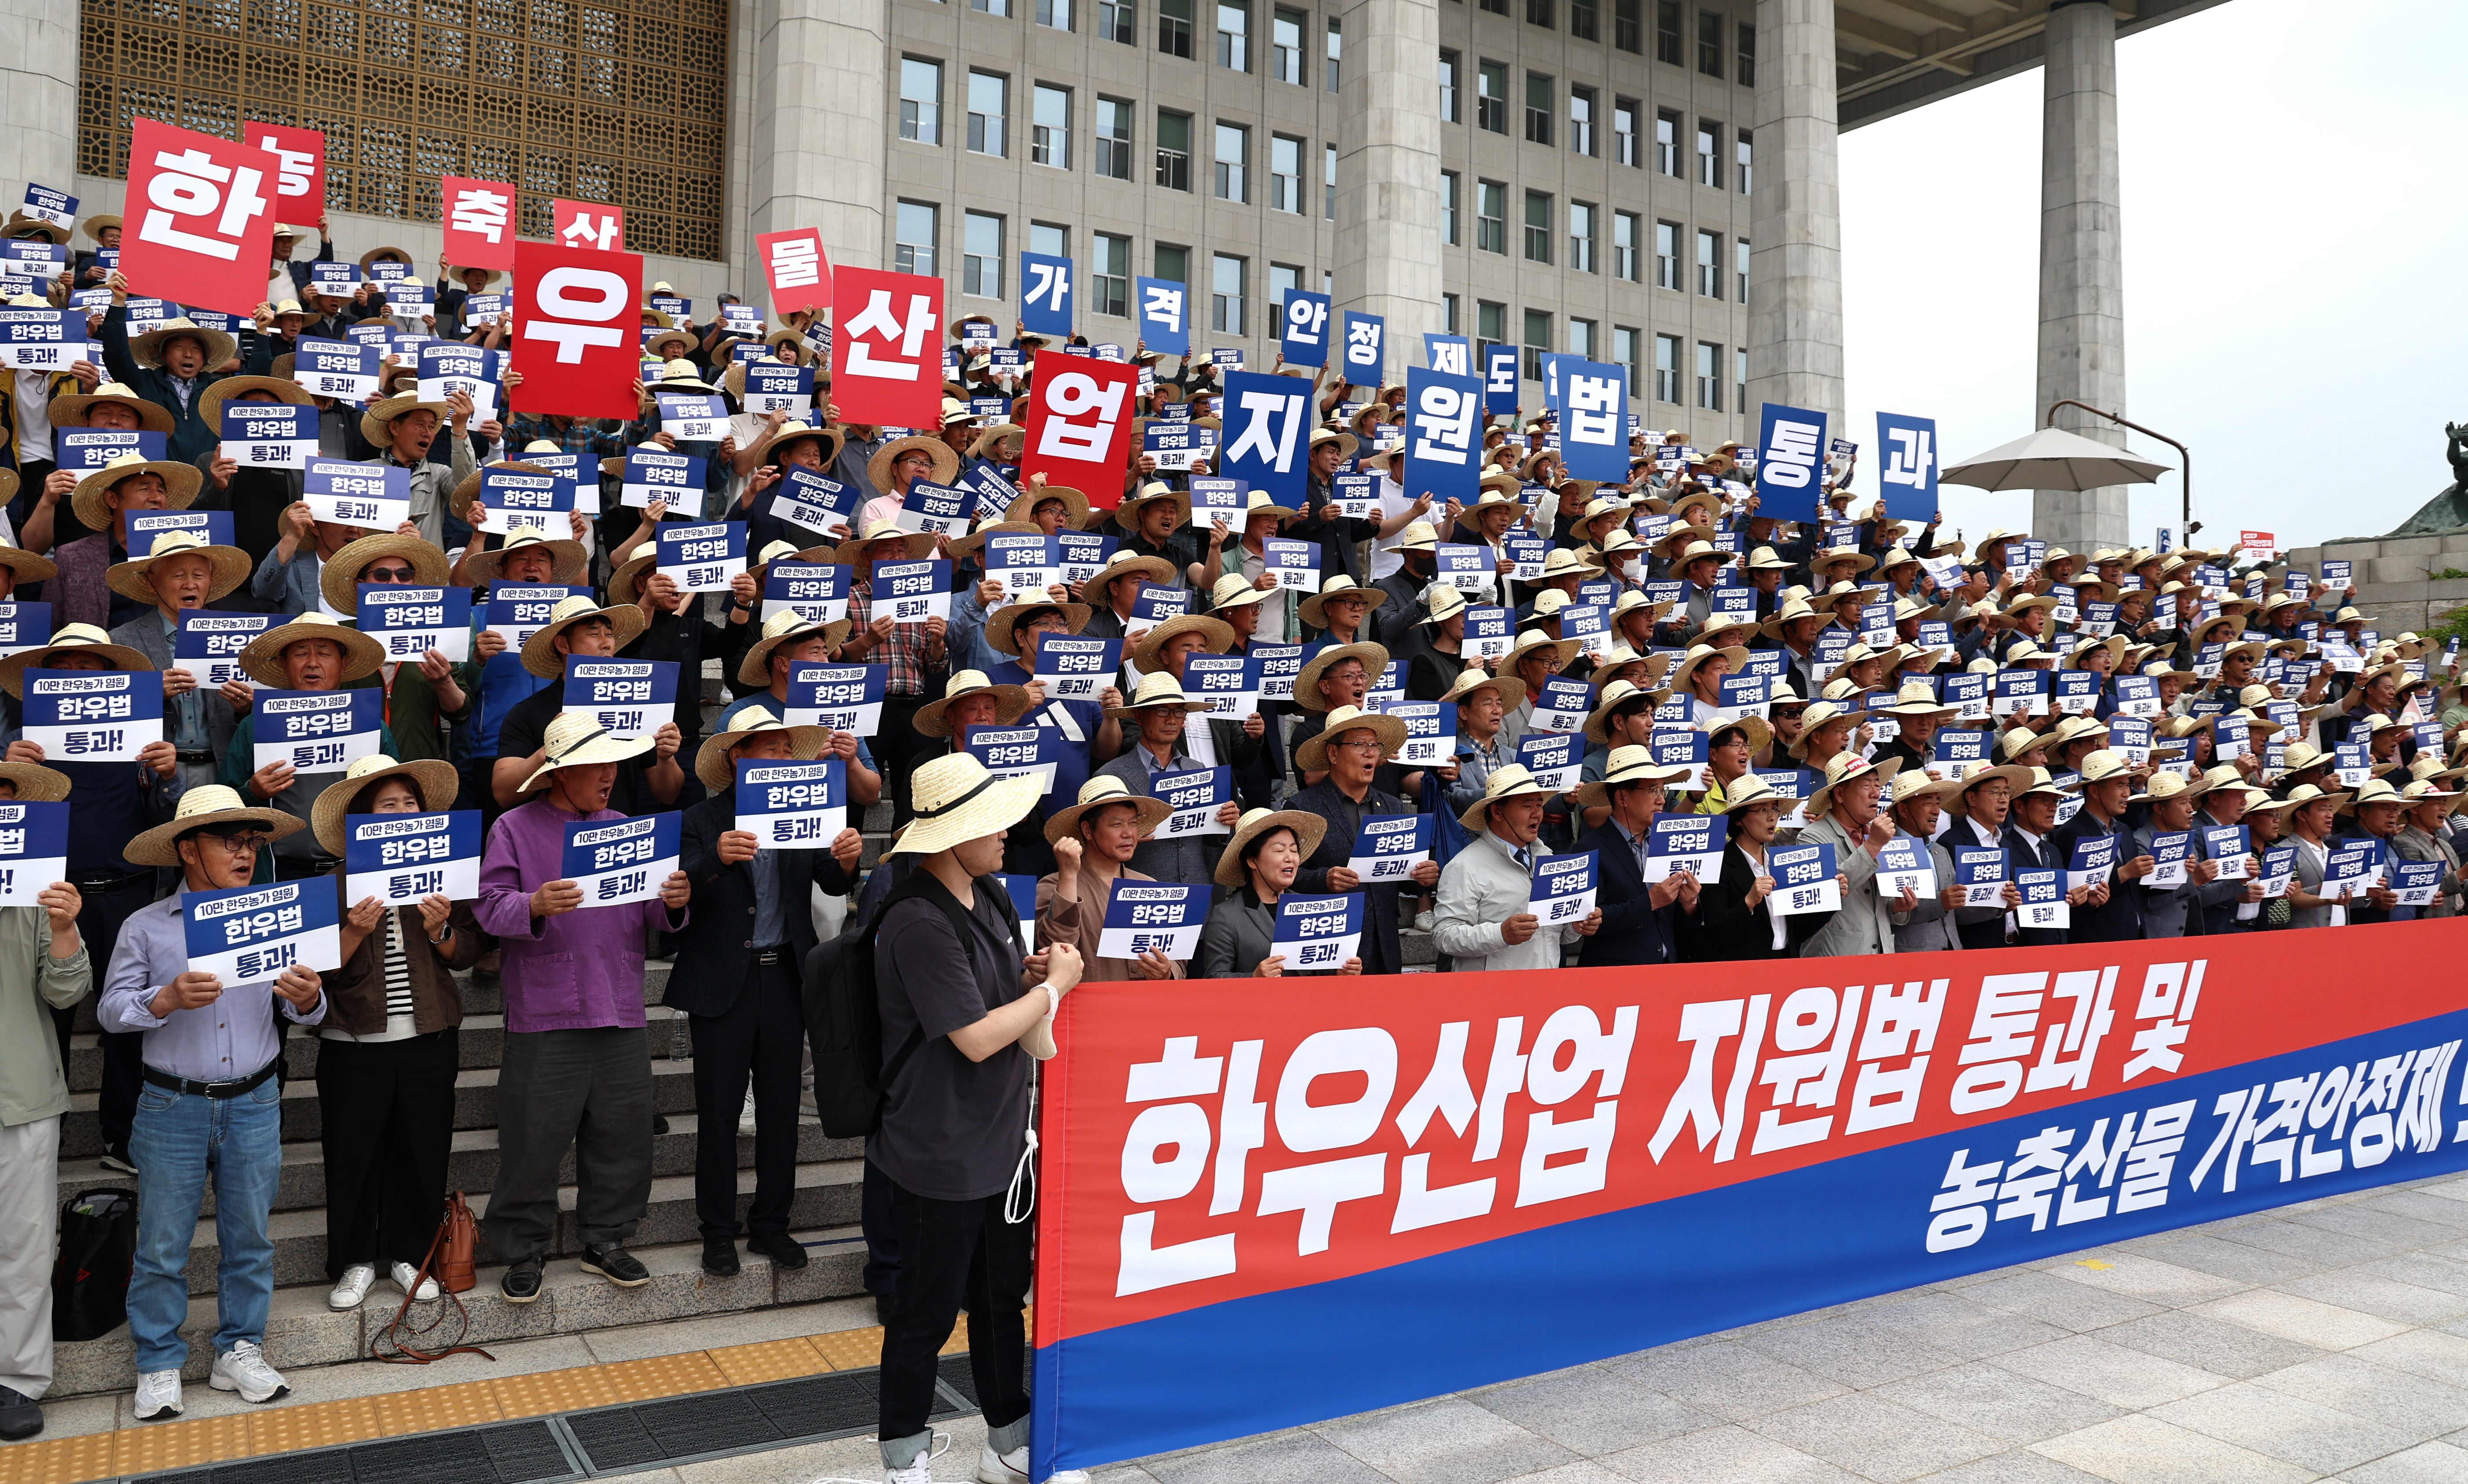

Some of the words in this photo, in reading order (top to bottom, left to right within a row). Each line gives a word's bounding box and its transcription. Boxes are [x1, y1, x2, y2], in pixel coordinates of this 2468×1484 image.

[261, 136, 314, 195] 농
[139, 149, 266, 261] 한
[452, 190, 507, 243] 축
[21, 250, 51, 260] 한우법
[771, 238, 819, 289] 물
[24, 263, 47, 273] 통과!
[324, 272, 350, 280] 한우법
[327, 284, 346, 293] 통과!
[1025, 264, 1069, 311] 가
[398, 294, 422, 302] 한우법
[524, 268, 628, 364] 우
[1144, 287, 1182, 332] 격
[1287, 300, 1327, 344] 안
[11, 325, 62, 340] 한우법
[844, 290, 936, 381] 산
[1349, 321, 1380, 365] 정
[17, 348, 57, 364] 통과!
[317, 355, 360, 371] 한우법
[1432, 342, 1466, 376] 제
[1488, 355, 1514, 392] 도
[320, 377, 354, 393] 통과!
[763, 378, 798, 391] 한우법
[676, 405, 712, 417] 한우법
[1037, 373, 1127, 463] 업
[1569, 375, 1620, 445] 법
[246, 421, 296, 437] 한우법
[684, 423, 711, 436] 통과!
[1227, 392, 1304, 472] 지
[1414, 386, 1476, 464] 원
[1159, 435, 1188, 448] 한우법
[251, 445, 290, 462] 통과!
[1161, 453, 1184, 465] 통과!
[1763, 420, 1819, 487] 통
[1884, 428, 1932, 489] 과
[646, 467, 687, 484] 한우법
[331, 477, 385, 495] 한우법
[1346, 486, 1370, 497] 한우법
[504, 490, 552, 507] 한우법
[797, 487, 837, 508] 한우법
[335, 502, 378, 520] 통과!
[792, 506, 825, 525] 통과!
[1346, 503, 1366, 513] 통과!
[683, 528, 710, 538] 한우농가
[712, 526, 725, 535] 염원
[681, 539, 727, 560] 한우법
[1006, 550, 1045, 565] 한우법
[1068, 547, 1101, 561] 한우법
[1280, 553, 1308, 566] 한우법
[1451, 557, 1481, 569] 한우법
[687, 566, 723, 586] 통과!
[895, 565, 917, 574] 한우농가
[918, 563, 930, 572] 염원
[893, 576, 932, 595] 한우법
[1011, 573, 1042, 588] 통과!
[1284, 572, 1304, 584] 통과!
[1455, 576, 1479, 588] 통과!
[385, 606, 443, 626] 한우법
[896, 600, 928, 617] 통과!
[2092, 612, 2113, 620] 한우법
[1479, 621, 1505, 635] 한우법
[1869, 616, 1888, 628] 한우법
[1873, 632, 1887, 644] 통과!
[1481, 641, 1502, 655] 통과!
[1058, 655, 1103, 671] 한우법
[1264, 658, 1301, 674] 한우법
[38, 681, 60, 691] 10만
[62, 679, 103, 691] 한우농가
[106, 677, 127, 688] 염원
[594, 681, 651, 701] 한우법
[1057, 680, 1093, 694] 통과!
[2009, 681, 2036, 694] 한우법
[2068, 682, 2090, 694] 한우법
[2129, 687, 2152, 698] 한우법
[815, 683, 865, 704] 한우법
[1555, 694, 1585, 709] 한우법
[58, 695, 130, 720] 한우법
[268, 701, 288, 710] 10만
[290, 698, 327, 709] 한우농가
[329, 696, 348, 706] 염원
[2068, 699, 2084, 709] 통과!
[2134, 703, 2151, 714] 통과!
[286, 711, 351, 737] 한우법
[1551, 715, 1577, 729] 통과!
[64, 730, 123, 754] 통과!
[293, 743, 345, 768] 통과!
[1951, 745, 1980, 758] 한우법
[751, 770, 770, 780] 10만
[772, 768, 806, 779] 한우농가
[808, 767, 825, 777] 염원
[768, 783, 827, 808] 한우법
[361, 825, 382, 836] 10만
[385, 820, 423, 834] 한우농가
[426, 817, 445, 829] 염원
[773, 817, 821, 841] 통과!
[1170, 812, 1206, 832] 통과!
[580, 832, 598, 843] 10만
[599, 825, 633, 840] 한우농가
[635, 821, 652, 833] 염원
[381, 835, 449, 864] 한우법
[1375, 833, 1416, 853] 한우법
[1668, 833, 1709, 852] 한우법
[595, 834, 654, 869] 한우법
[2159, 845, 2185, 861] 한우법
[1374, 859, 1408, 877] 통과!
[1787, 862, 1822, 884] 한우법
[2156, 865, 2176, 880] 통과!
[389, 871, 442, 898] 통과!
[598, 871, 646, 900] 통과!
[1551, 871, 1588, 894] 한우법
[2407, 873, 2435, 885] 한우법
[1793, 888, 1820, 908] 통과!
[2028, 884, 2056, 900] 한우법
[2404, 890, 2428, 901] 통과!
[200, 902, 224, 916] 10만
[226, 893, 271, 912] 한우농가
[273, 887, 296, 901] 염원
[1290, 904, 1304, 912] 10만
[1304, 901, 1332, 912] 한우농가
[1333, 900, 1346, 909] 염원
[1550, 899, 1582, 919] 통과!
[1132, 904, 1186, 924] 한우법
[2033, 907, 2053, 923] 통과!
[224, 903, 302, 944] 한우법
[1300, 914, 1347, 937] 한우법
[236, 943, 296, 978] 통과!
[1300, 944, 1339, 964] 통과!
[1115, 1006, 1639, 1297] 한우산업
[1647, 979, 1950, 1165] 지원법
[1950, 966, 2120, 1114] 통과
[2123, 960, 2207, 1082] 및
[1926, 1099, 2196, 1253] 농축산물
[2190, 1040, 2462, 1193] 가격안정제
